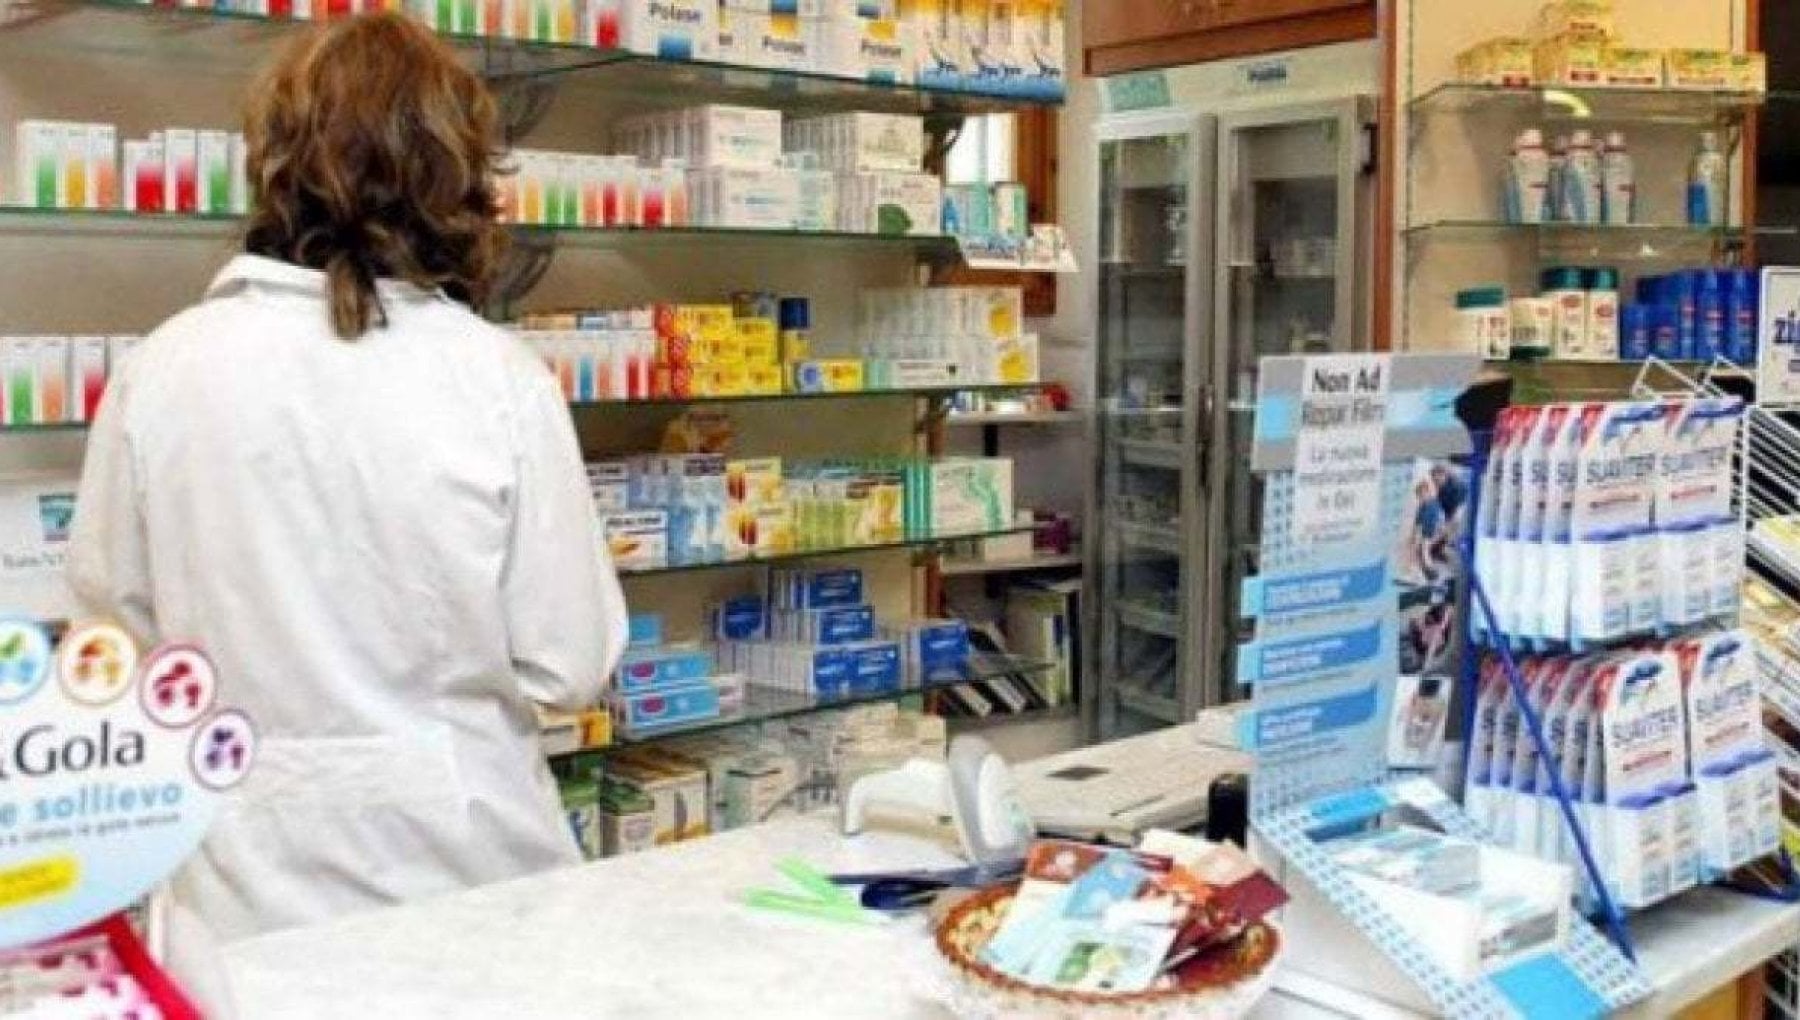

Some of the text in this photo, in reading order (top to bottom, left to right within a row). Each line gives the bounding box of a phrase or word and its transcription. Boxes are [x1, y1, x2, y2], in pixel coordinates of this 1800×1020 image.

[649, 2, 701, 24] Polase
[1314, 365, 1382, 392] Non Ad
[34, 781, 182, 822] sollievo
